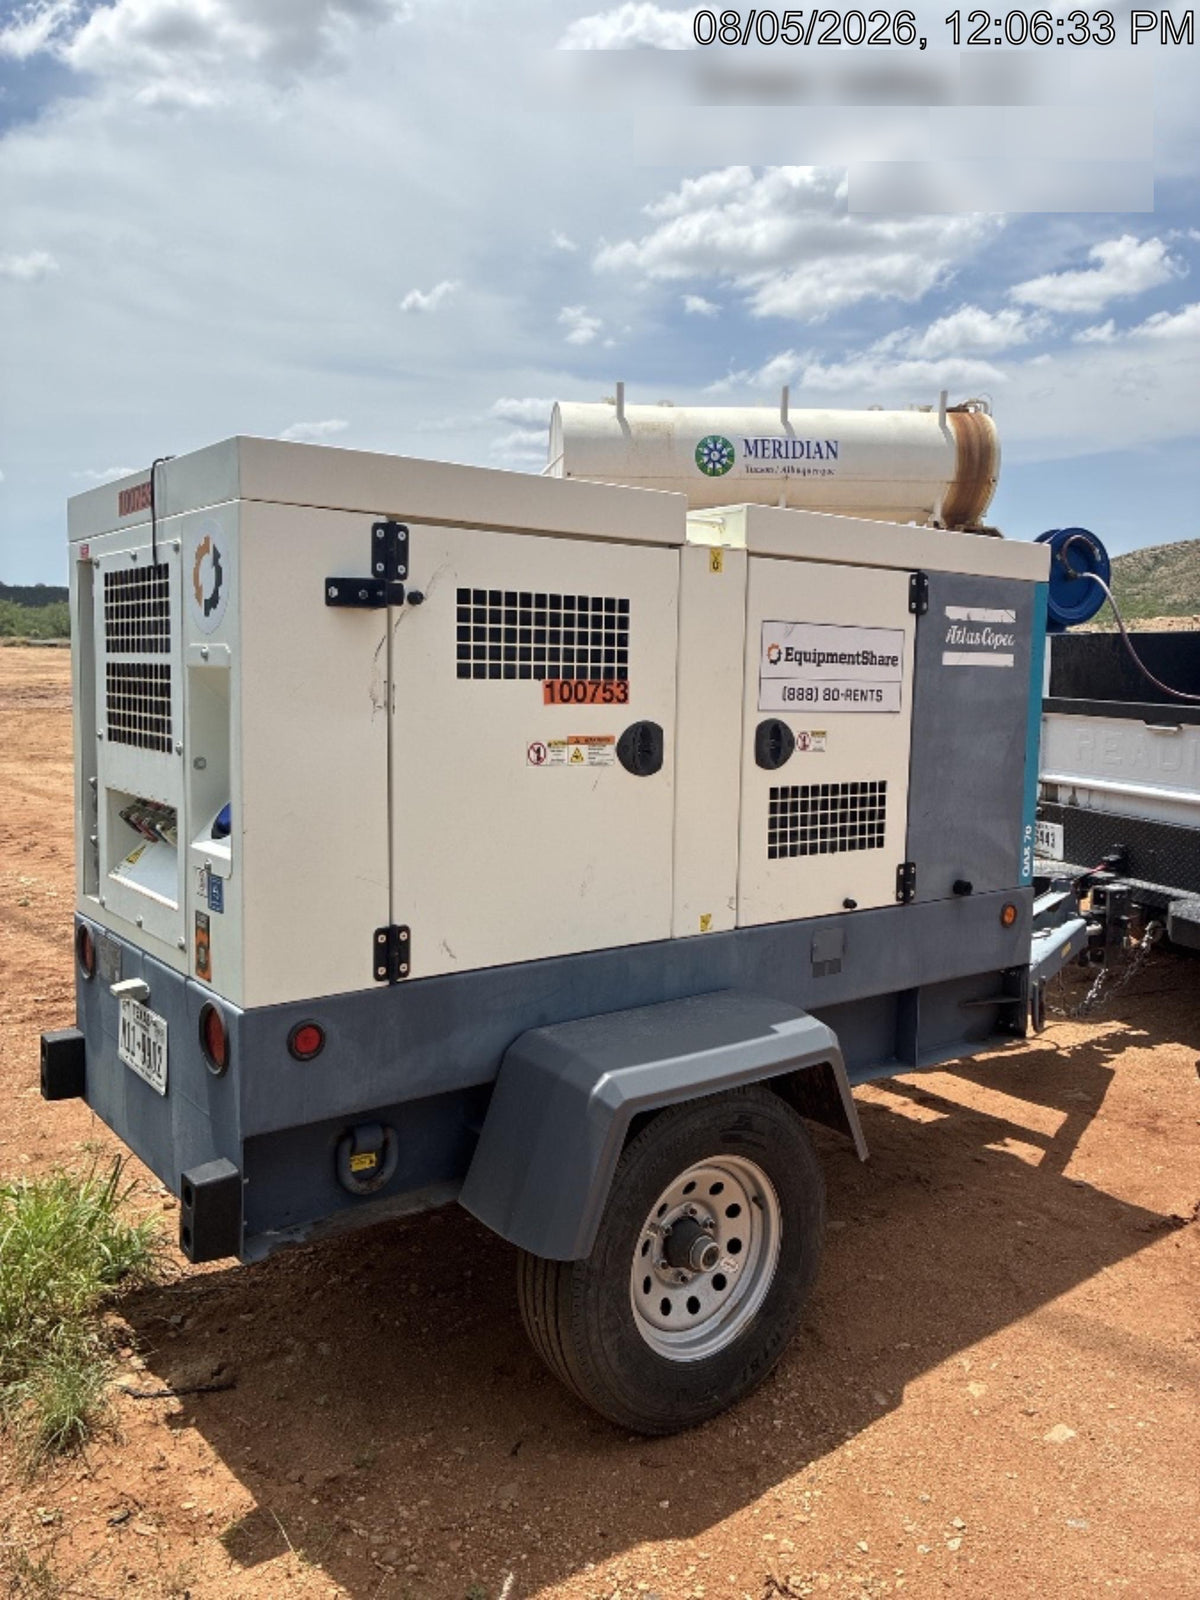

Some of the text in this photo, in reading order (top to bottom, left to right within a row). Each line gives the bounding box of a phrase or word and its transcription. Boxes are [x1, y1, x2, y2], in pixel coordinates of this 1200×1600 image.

[743, 438, 838, 460] MERIDIAN
[945, 625, 980, 645] Atlas
[784, 646, 899, 667] EquipmentShare
[544, 680, 629, 703] 100753
[782, 685, 883, 702] (888) 80-RENTS
